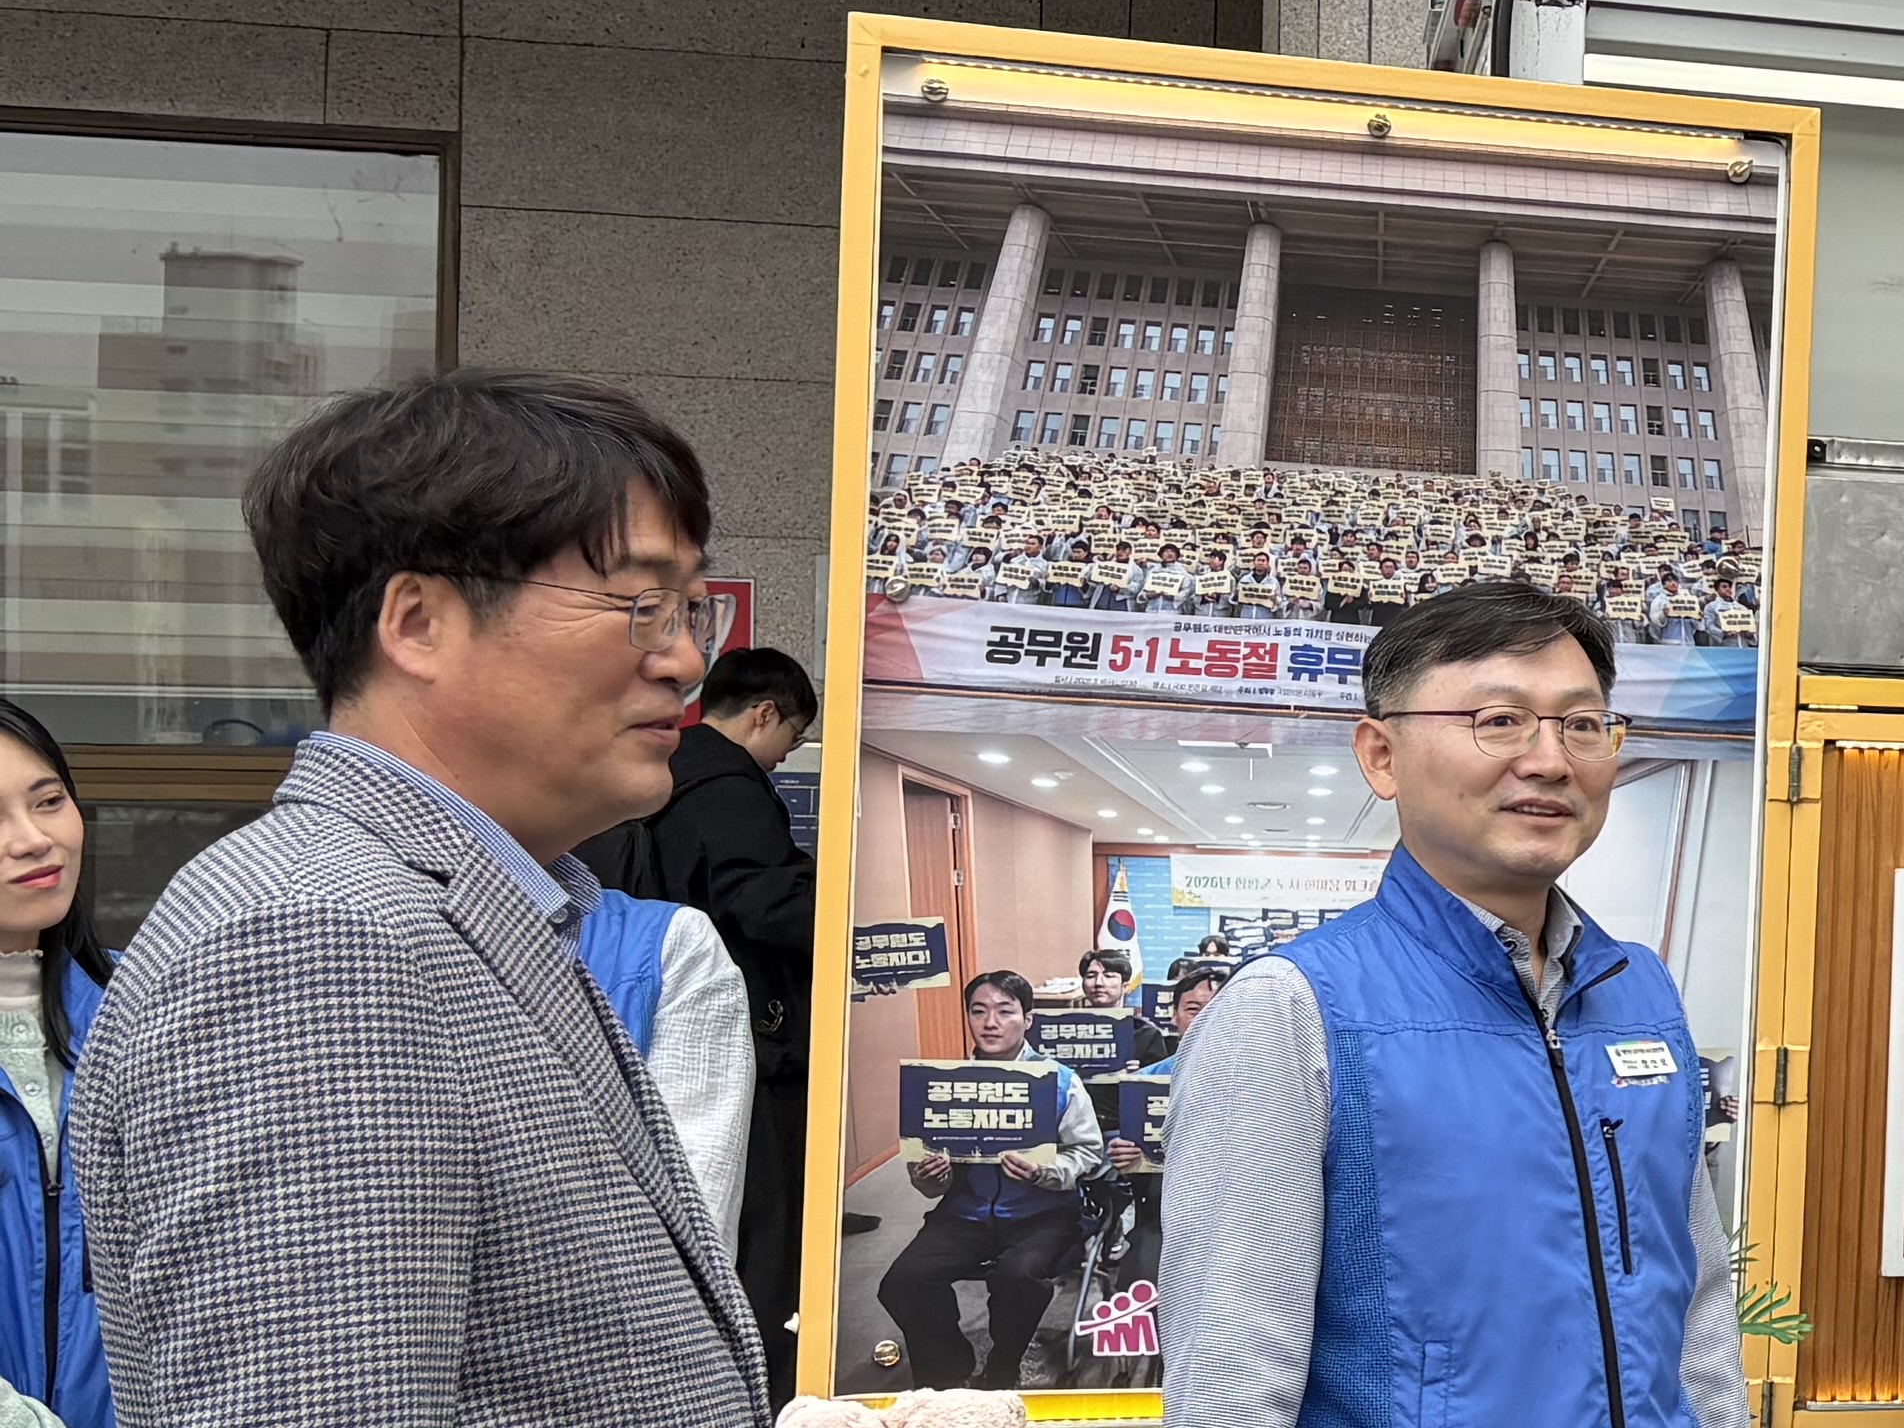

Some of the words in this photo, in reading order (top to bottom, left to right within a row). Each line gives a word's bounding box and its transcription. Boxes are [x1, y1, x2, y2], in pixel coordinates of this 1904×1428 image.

[984, 625, 1102, 671] 공무원
[1164, 635, 1280, 681] 노동절
[854, 931, 927, 951] 공무원도
[1040, 1023, 1114, 1040] 공무원도
[927, 1081, 1030, 1104] 공무원도
[923, 1107, 1034, 1130] 노동자다!
